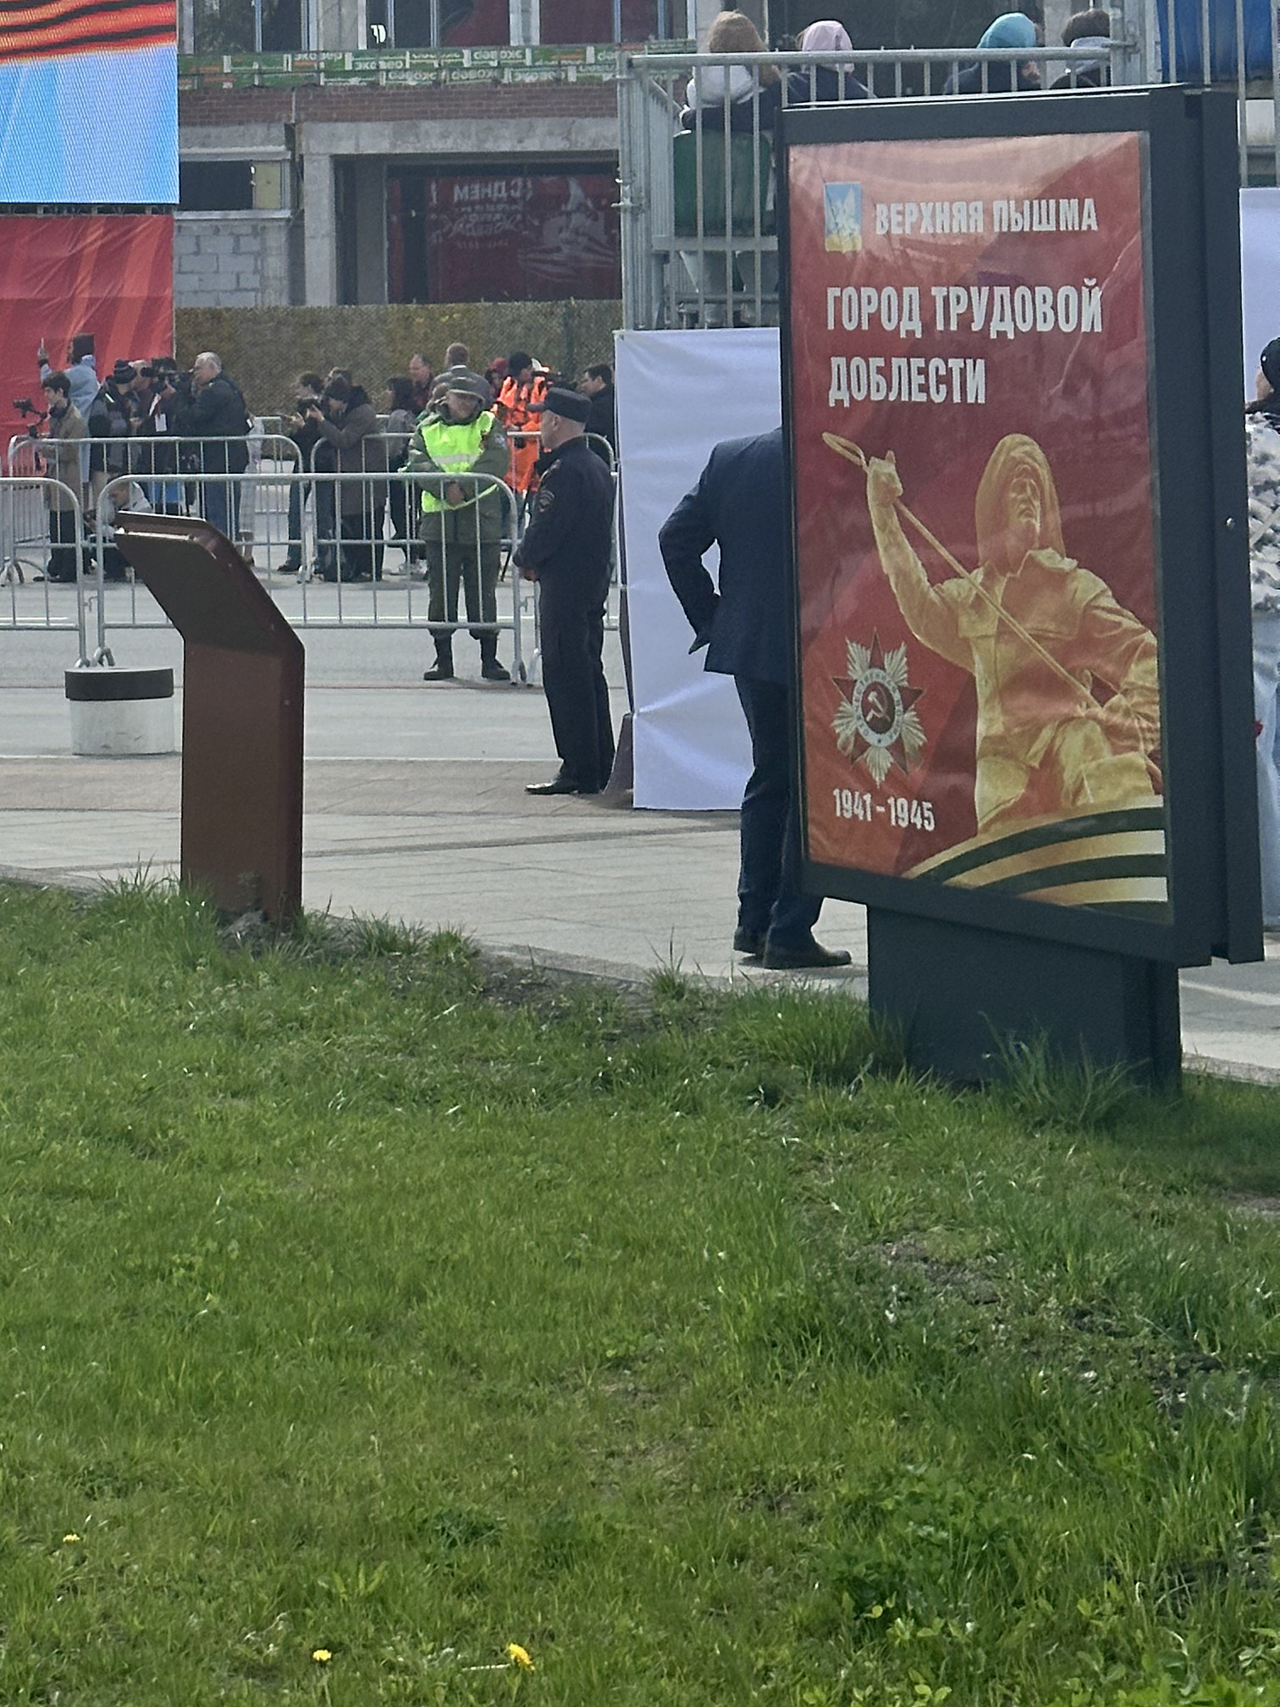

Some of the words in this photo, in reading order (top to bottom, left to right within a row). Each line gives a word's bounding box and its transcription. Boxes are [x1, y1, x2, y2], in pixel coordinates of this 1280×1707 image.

[875, 200, 984, 235] ВЕРХНЯЯ
[992, 197, 1098, 232] ПЫШМА
[826, 287, 922, 338] ГОРОД
[931, 278, 1102, 339] ТРУДОВОЙ
[829, 357, 986, 407] ДОБЛЕСТИ
